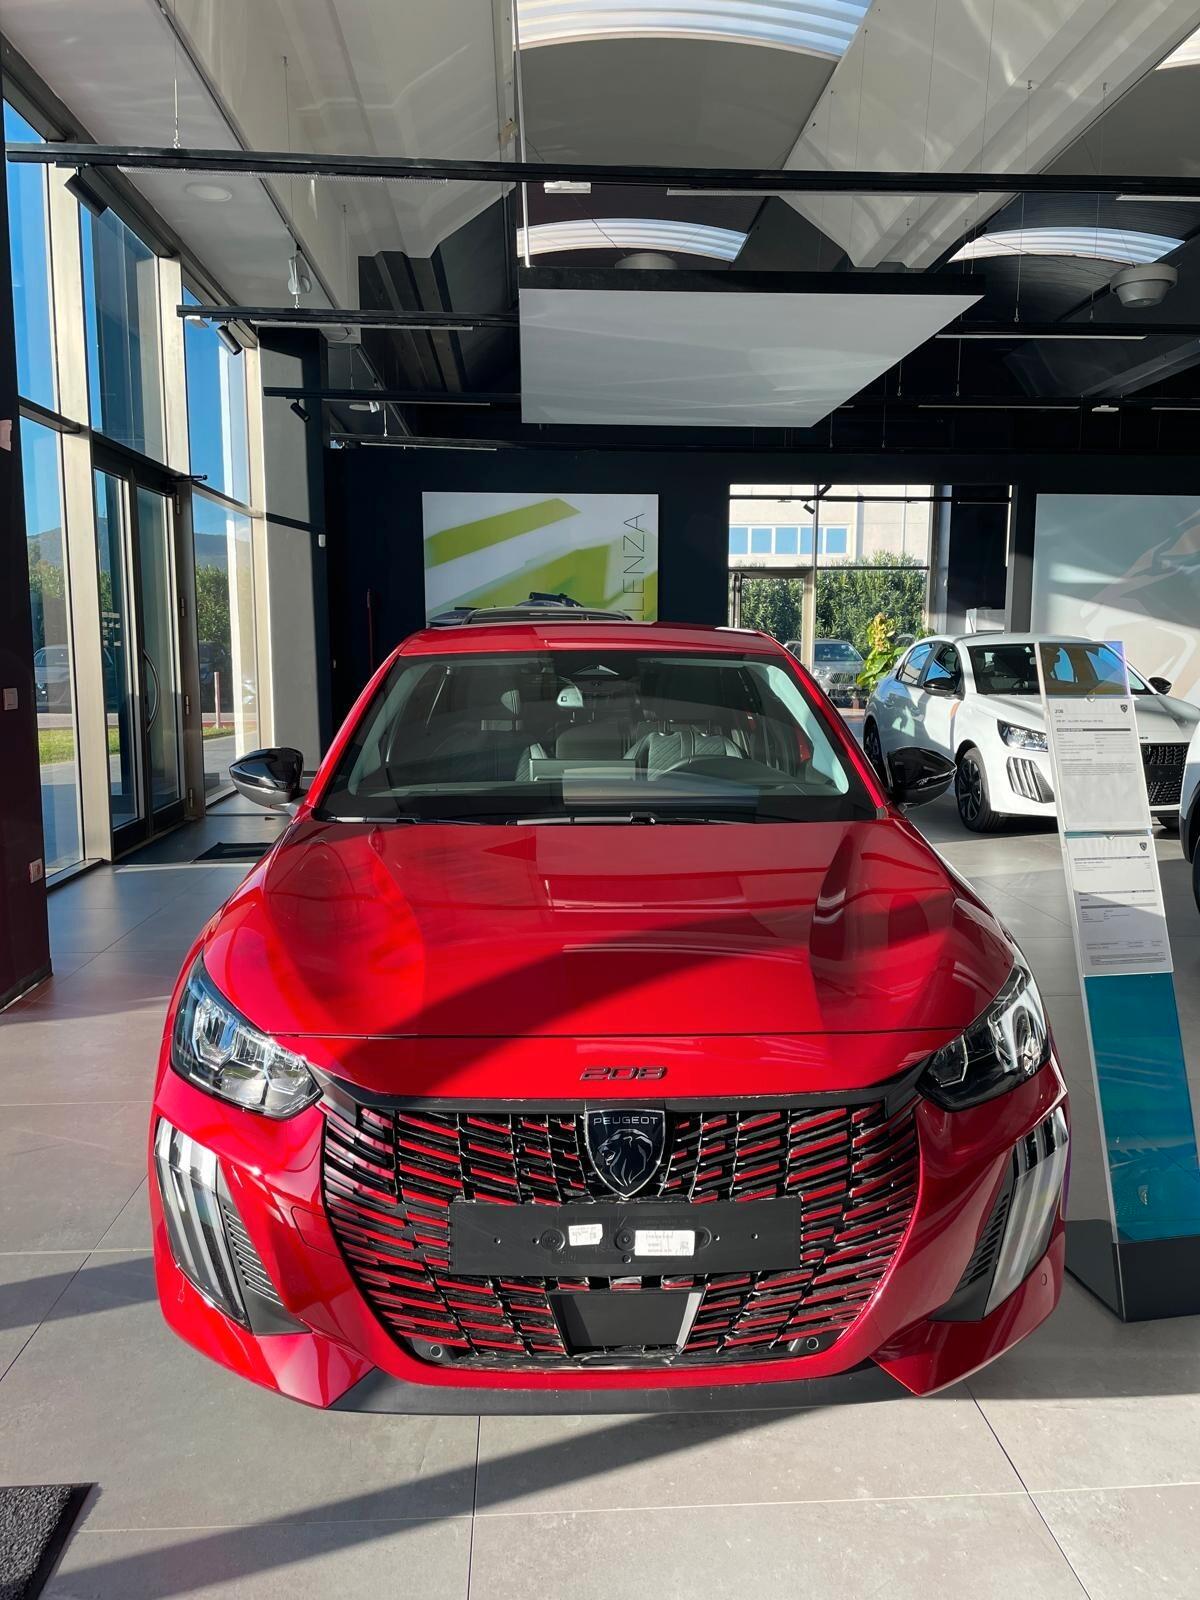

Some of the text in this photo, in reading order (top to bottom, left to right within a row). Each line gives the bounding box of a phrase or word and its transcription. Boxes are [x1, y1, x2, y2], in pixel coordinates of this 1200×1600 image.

[623, 513, 645, 620] LENZA
[580, 1066, 666, 1080] 208
[593, 1116, 659, 1126] PEUGEOT
